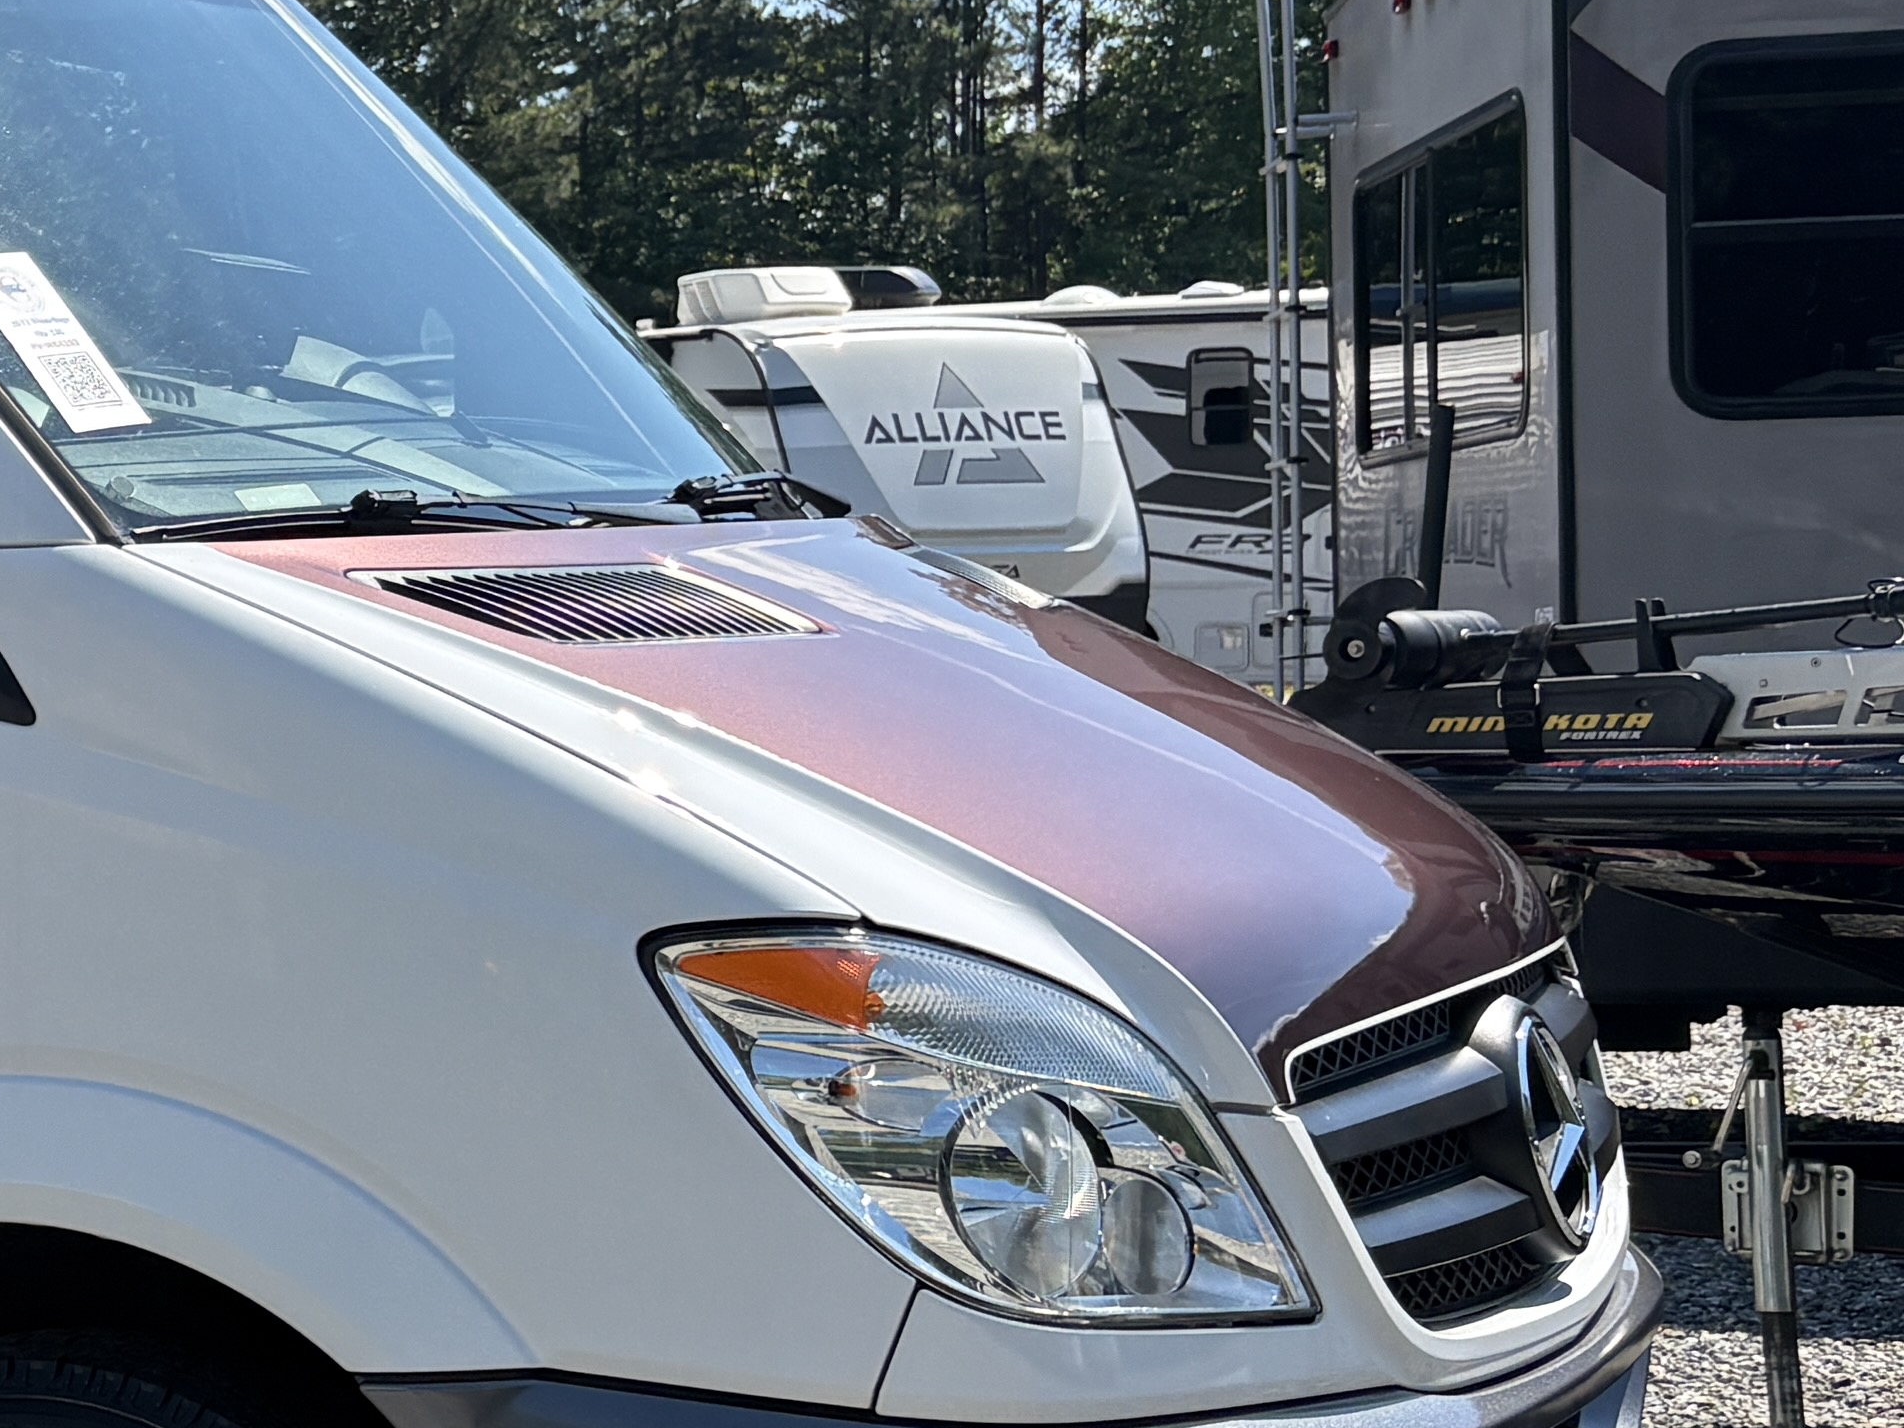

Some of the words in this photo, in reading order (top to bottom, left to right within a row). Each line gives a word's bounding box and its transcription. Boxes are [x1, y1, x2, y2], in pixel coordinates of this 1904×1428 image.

[864, 410, 1067, 445] ALLIANCE
[1382, 492, 1513, 588] CRADER
[1426, 715, 1507, 733] MIN
[1542, 712, 1656, 732] KOTA
[1559, 730, 1645, 742] FORTREX
